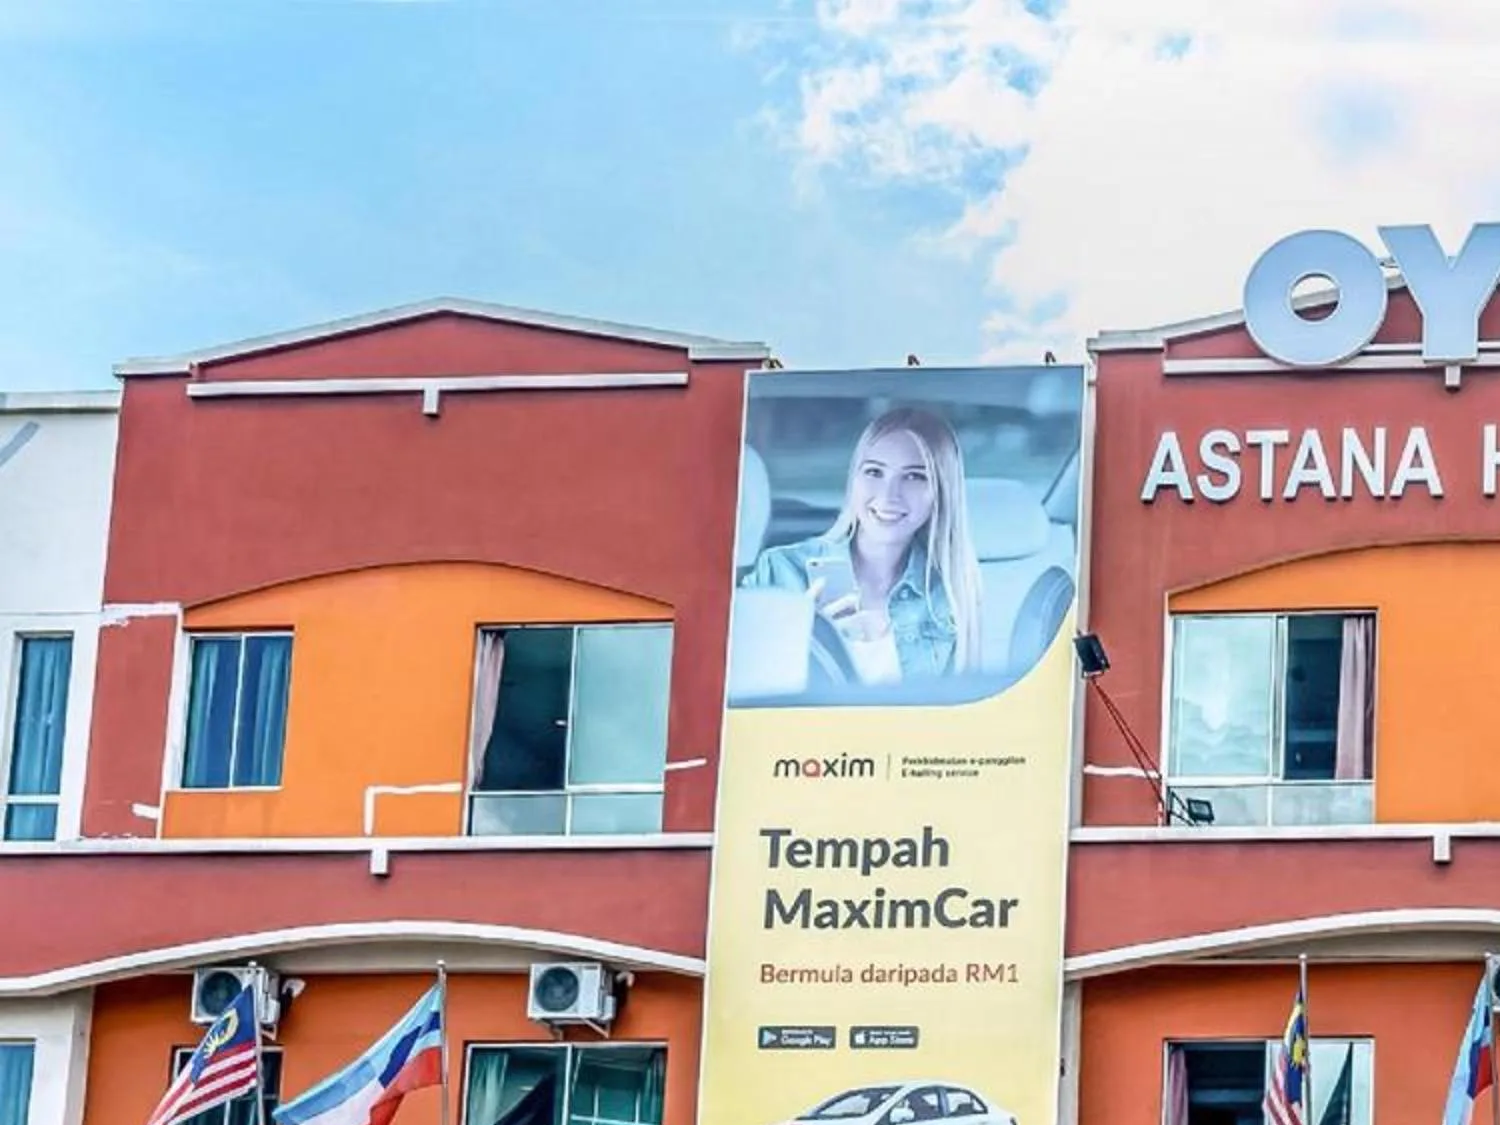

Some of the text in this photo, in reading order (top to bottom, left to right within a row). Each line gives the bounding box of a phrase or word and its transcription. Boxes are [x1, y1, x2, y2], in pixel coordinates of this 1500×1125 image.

[1141, 427, 1443, 502] ASTANA
[773, 752, 875, 778] maxim
[759, 827, 950, 875] Tempah
[763, 888, 1019, 930] MaximCar
[759, 962, 1019, 988] Bermula daripada RM1
